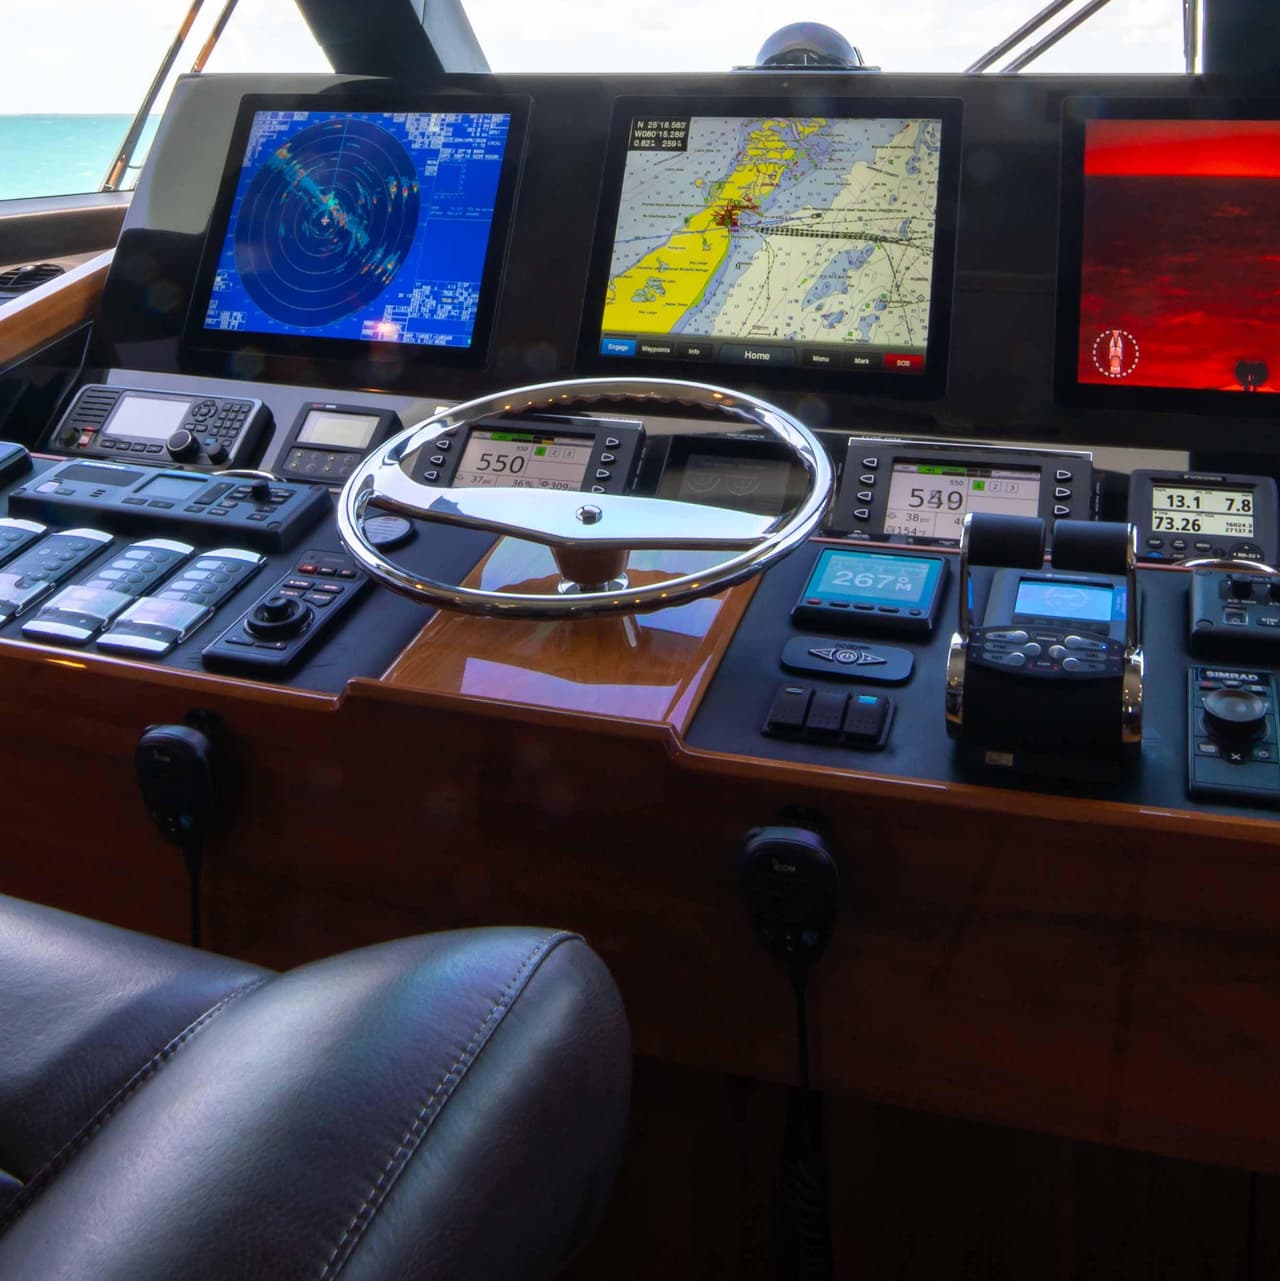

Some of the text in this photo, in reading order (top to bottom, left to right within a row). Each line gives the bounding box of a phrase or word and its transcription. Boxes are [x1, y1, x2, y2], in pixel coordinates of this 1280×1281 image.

[637, 121, 644, 129] N
[642, 345, 671, 354] Waypoints
[744, 350, 771, 361] Home
[476, 453, 525, 474] 550
[908, 488, 964, 511] 549
[1167, 494, 1201, 509] 13.1
[1225, 498, 1251, 512] 7.8
[1154, 516, 1201, 532] 73.26
[1205, 670, 1259, 682] SIMRAD
